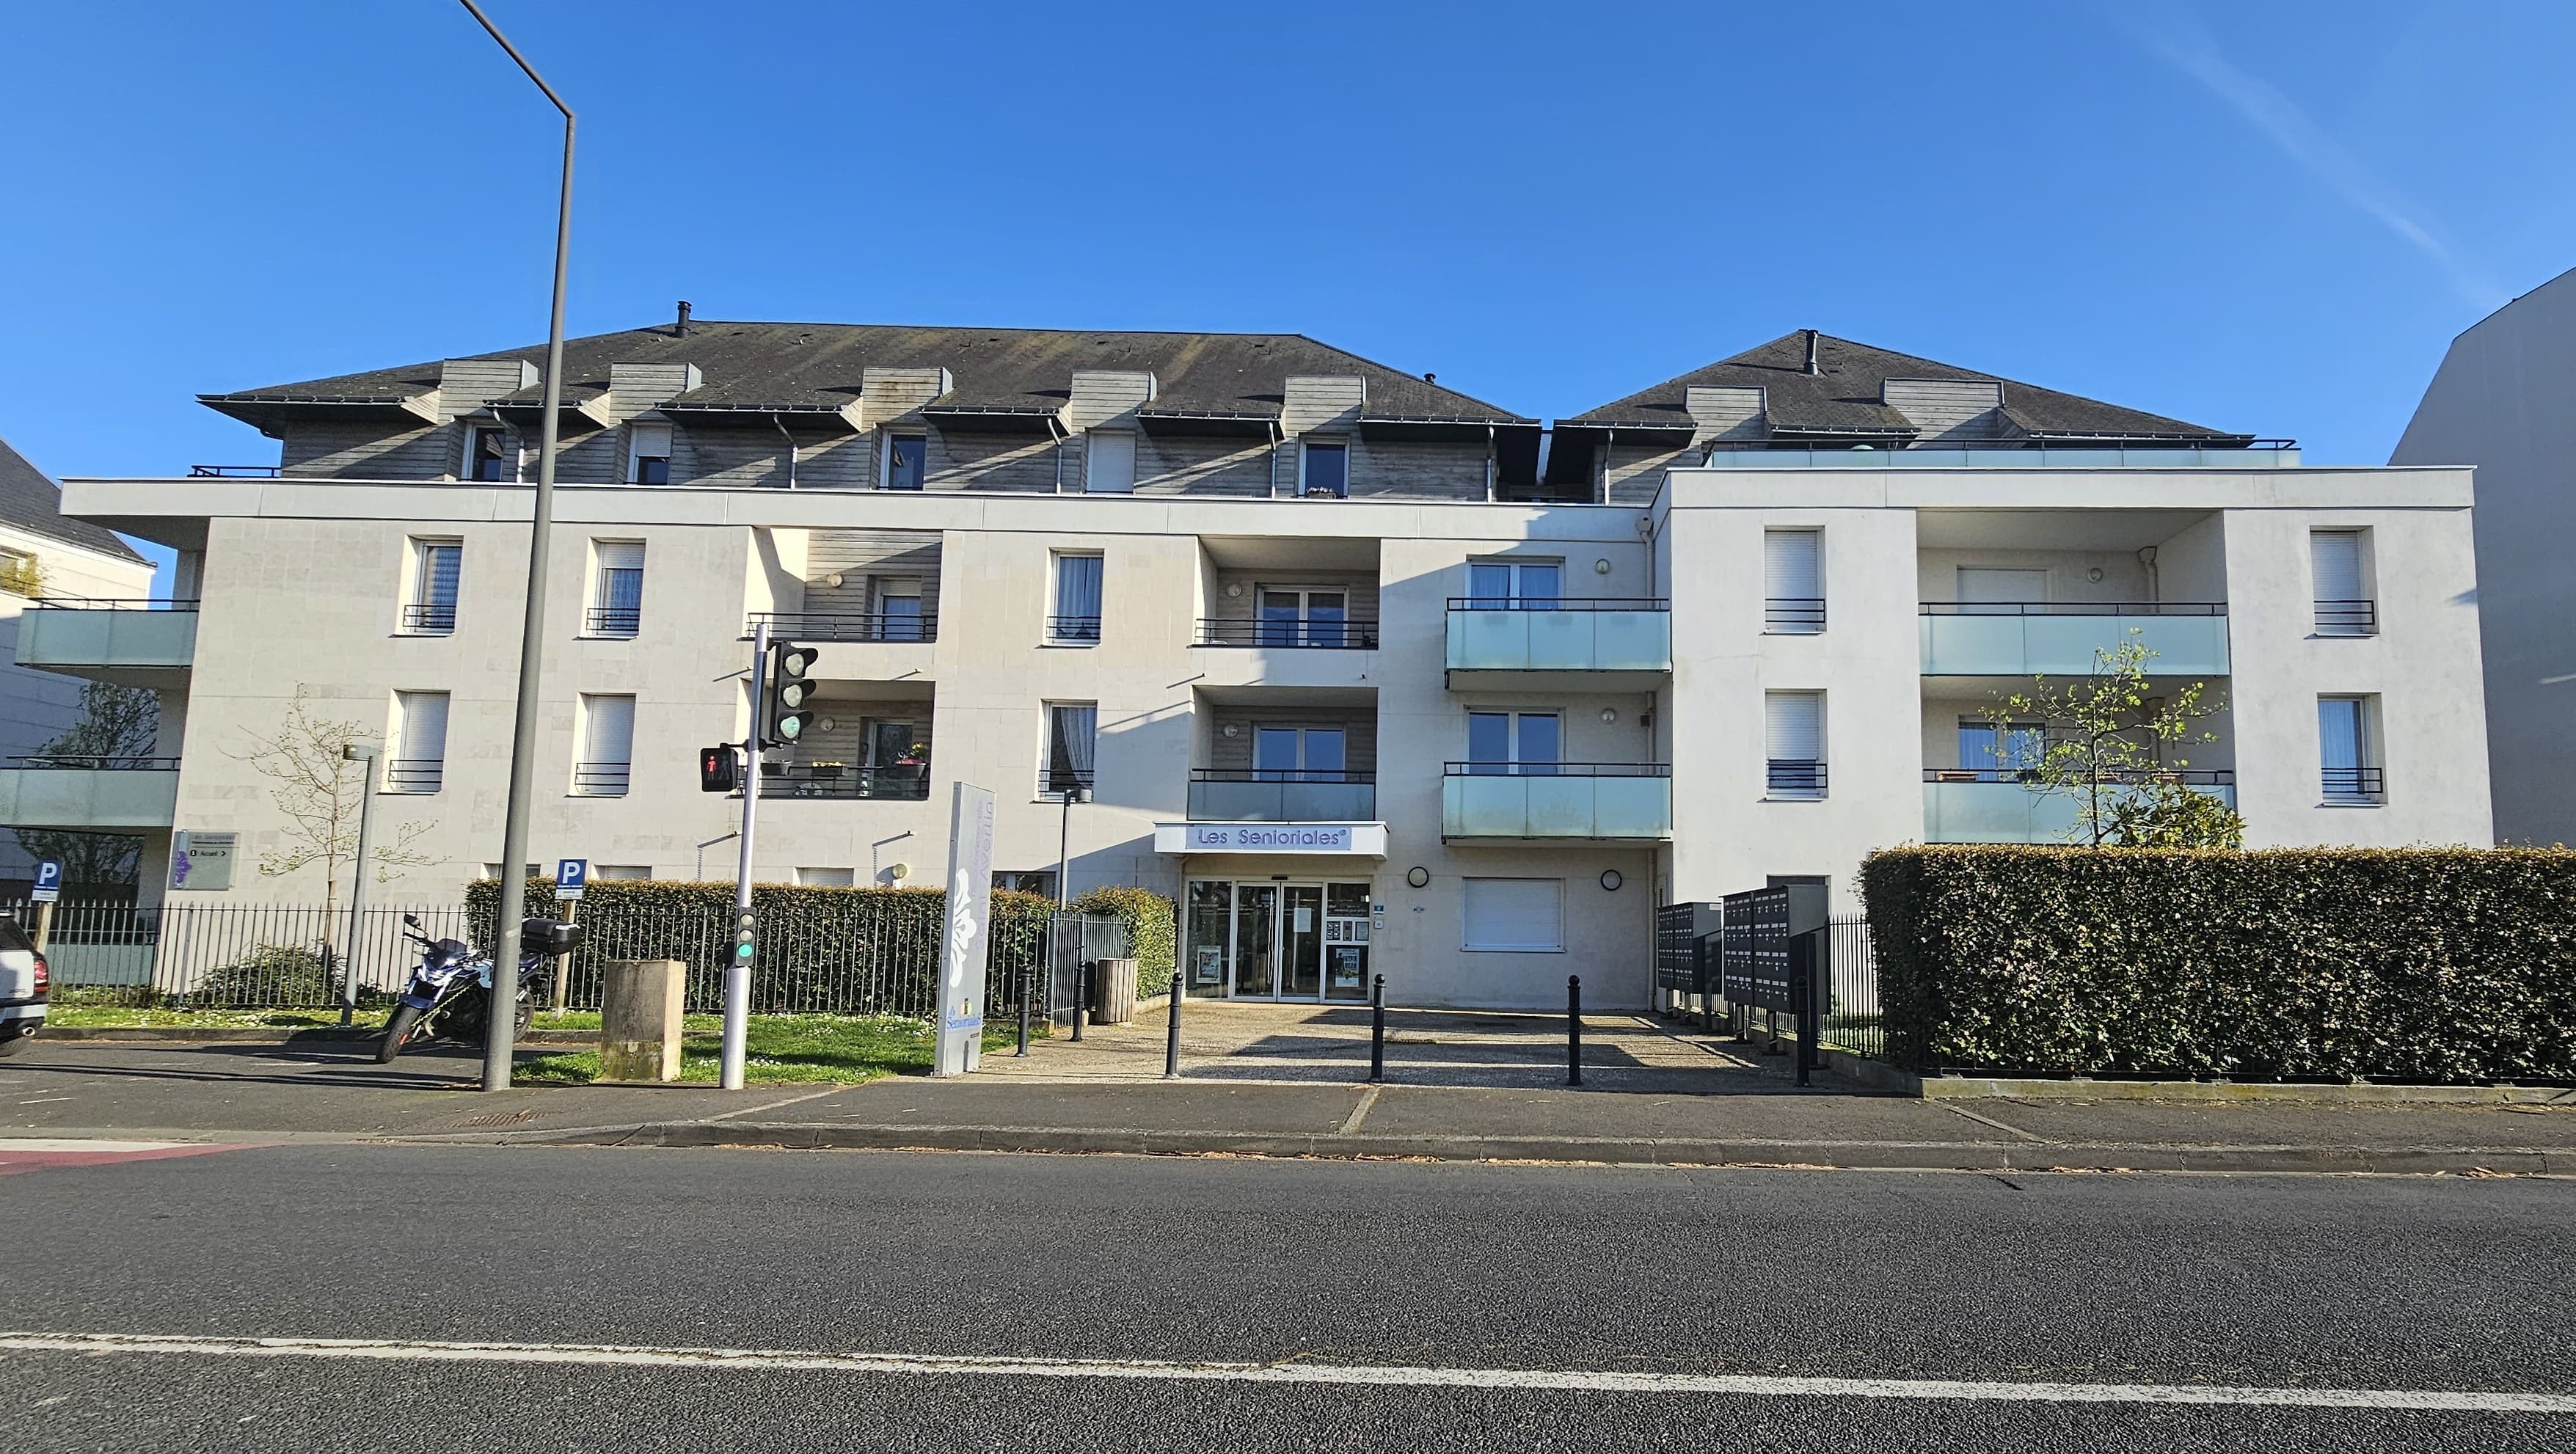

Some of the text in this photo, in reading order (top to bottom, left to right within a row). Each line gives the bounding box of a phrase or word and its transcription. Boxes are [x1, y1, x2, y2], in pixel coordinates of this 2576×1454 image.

[1199, 829, 1339, 845] Les Senioriales
[39, 862, 57, 885] P
[562, 861, 581, 884] P
